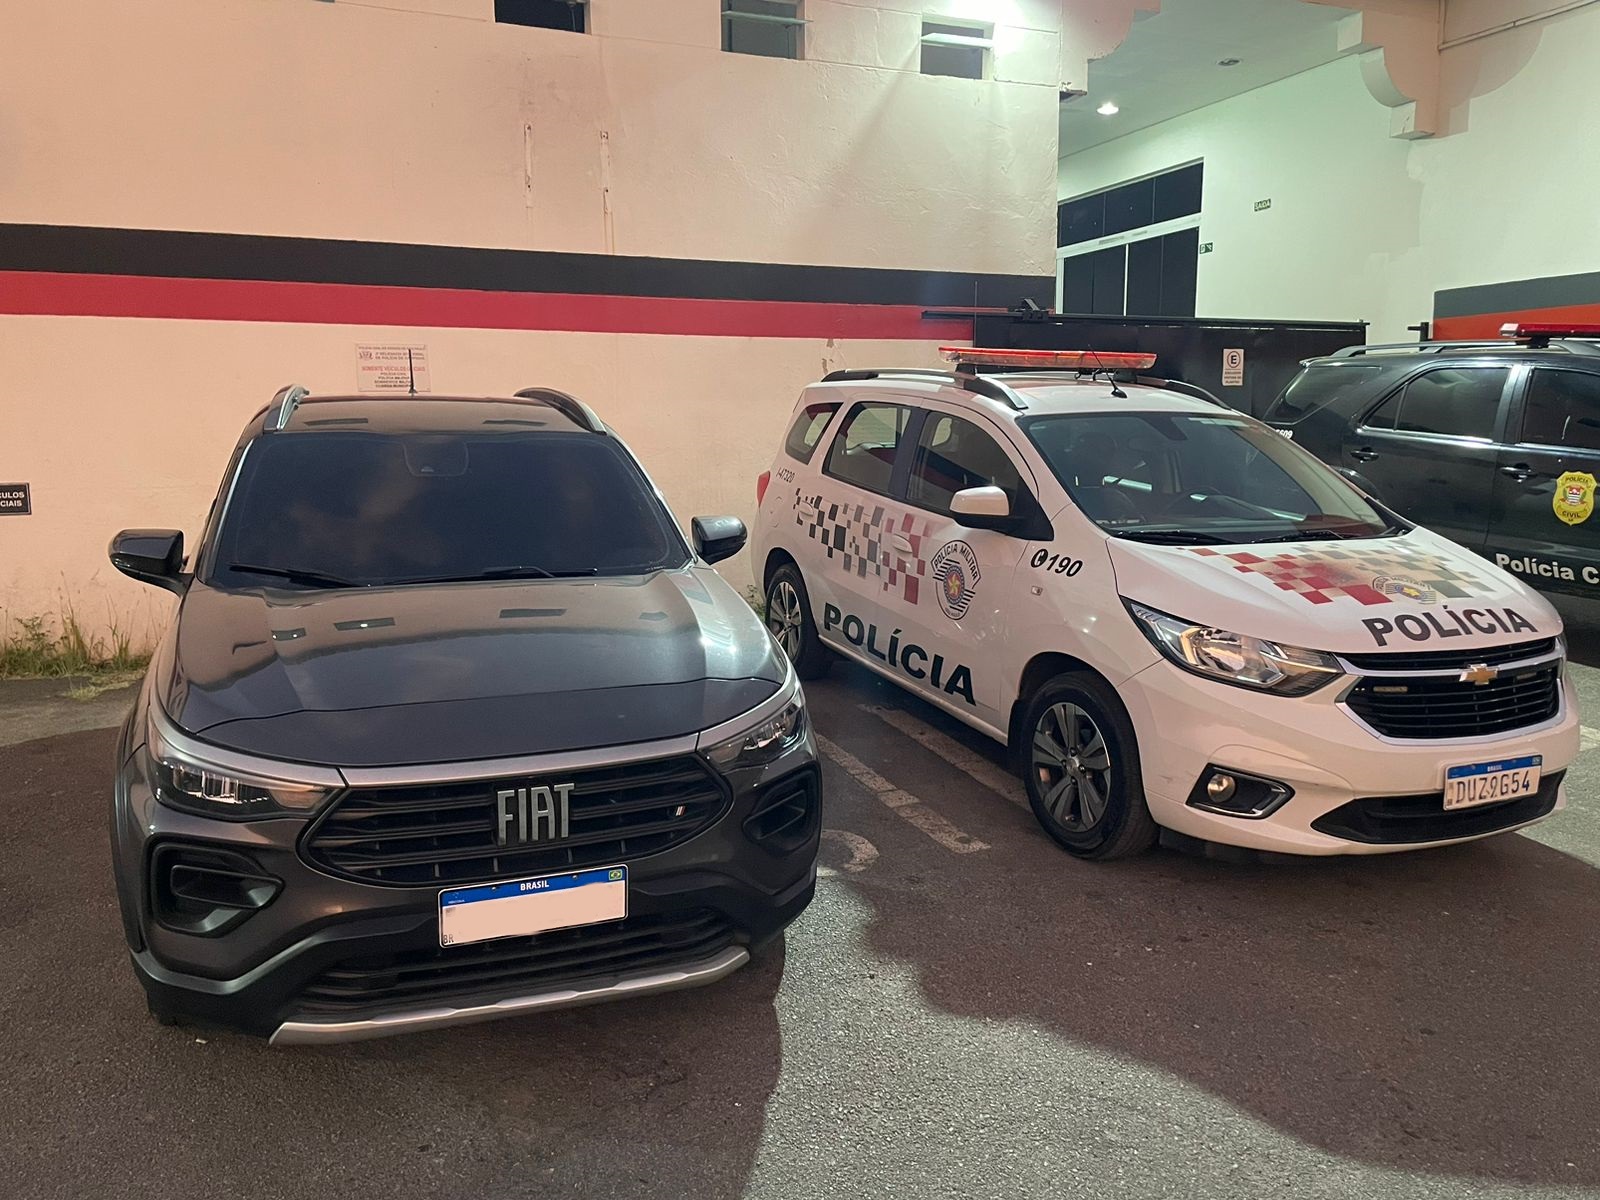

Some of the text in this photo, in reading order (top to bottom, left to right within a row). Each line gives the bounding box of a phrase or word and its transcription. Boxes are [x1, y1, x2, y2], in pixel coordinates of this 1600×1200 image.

[1230, 354, 1237, 365] E
[0, 491, 25, 499] ULOS
[1562, 510, 1581, 518] CIVIL
[959, 545, 978, 581] MILITAR
[1046, 554, 1083, 577] 190
[1495, 553, 1575, 581] Polícia
[1361, 604, 1538, 647] POLÍCIA
[823, 602, 977, 707] POLÍCIA
[497, 783, 575, 846] FIAT
[520, 880, 550, 891] BRASIL
[443, 934, 454, 944] BR
